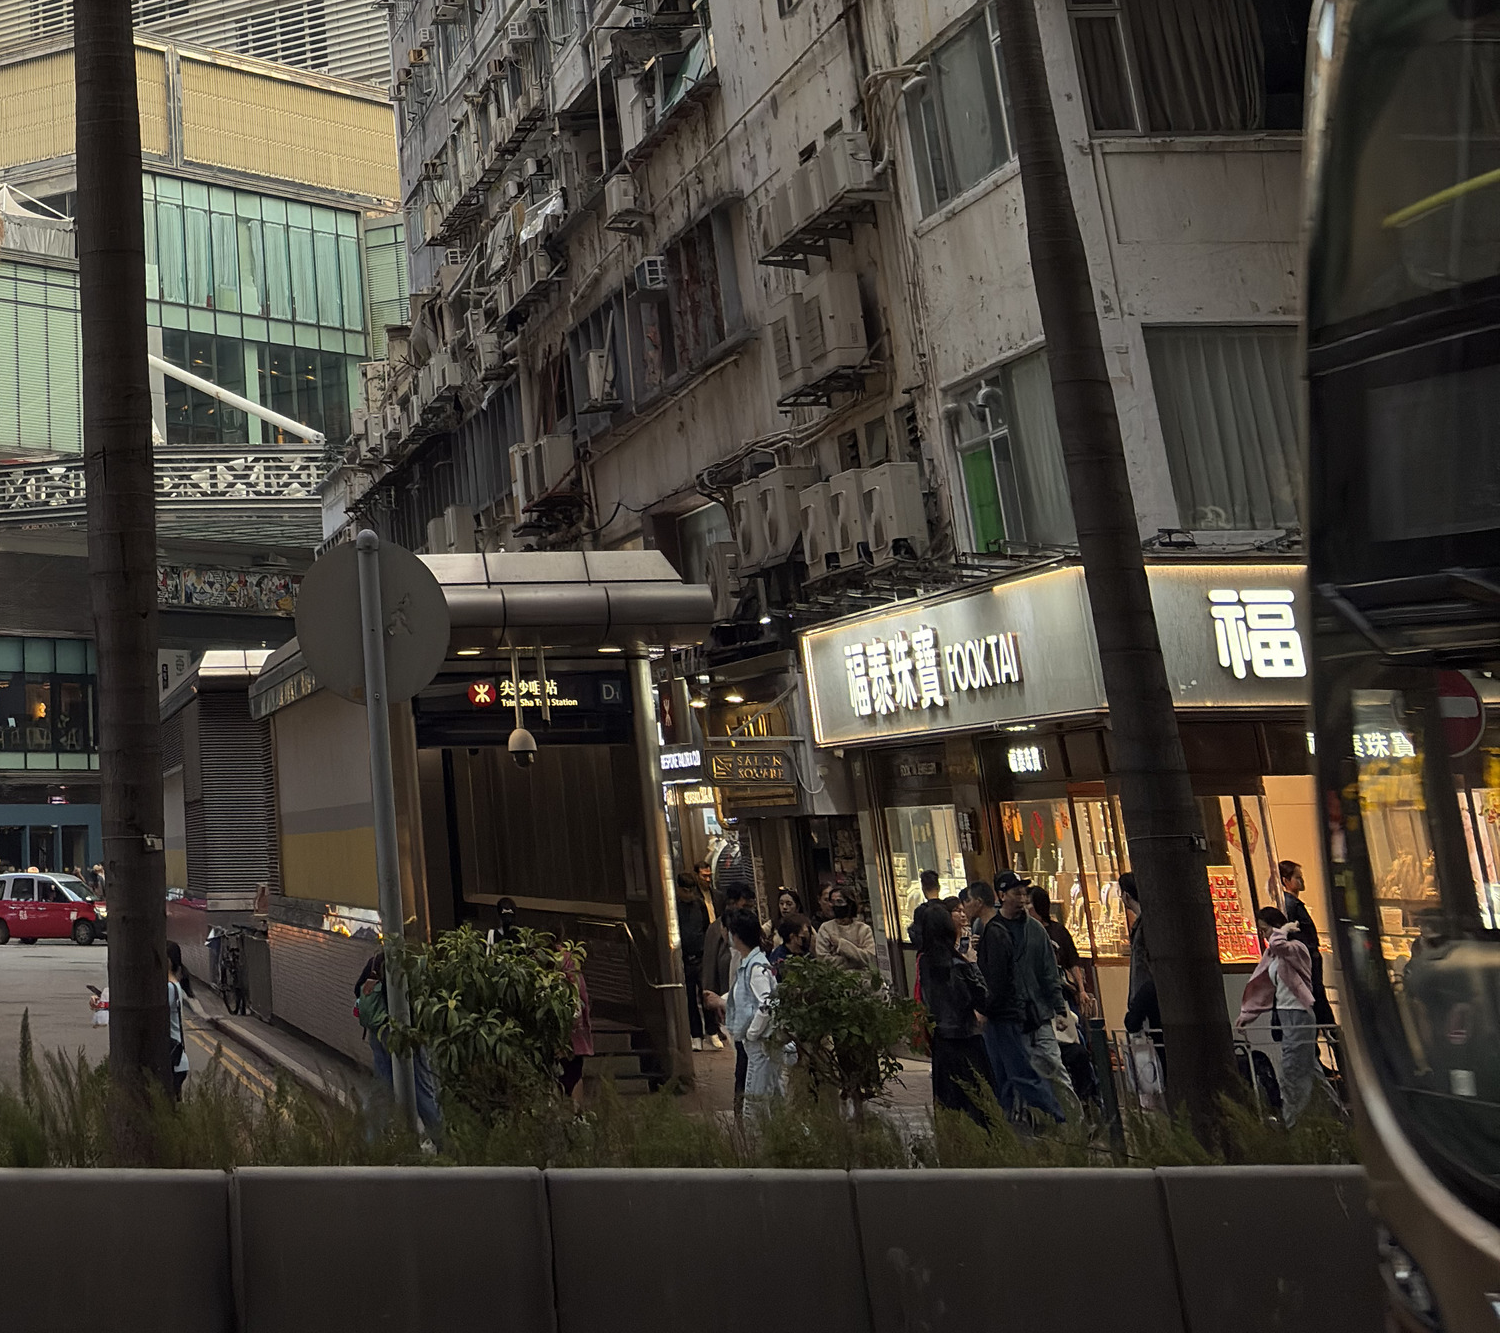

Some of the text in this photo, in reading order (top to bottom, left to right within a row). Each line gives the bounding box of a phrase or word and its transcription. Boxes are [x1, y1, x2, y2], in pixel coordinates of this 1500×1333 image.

[1208, 589, 1308, 680] 福
[843, 624, 945, 718] 福泰珠寶
[520, 698, 534, 707] Sha
[551, 698, 578, 707] Station
[737, 767, 785, 779] SQUARE
